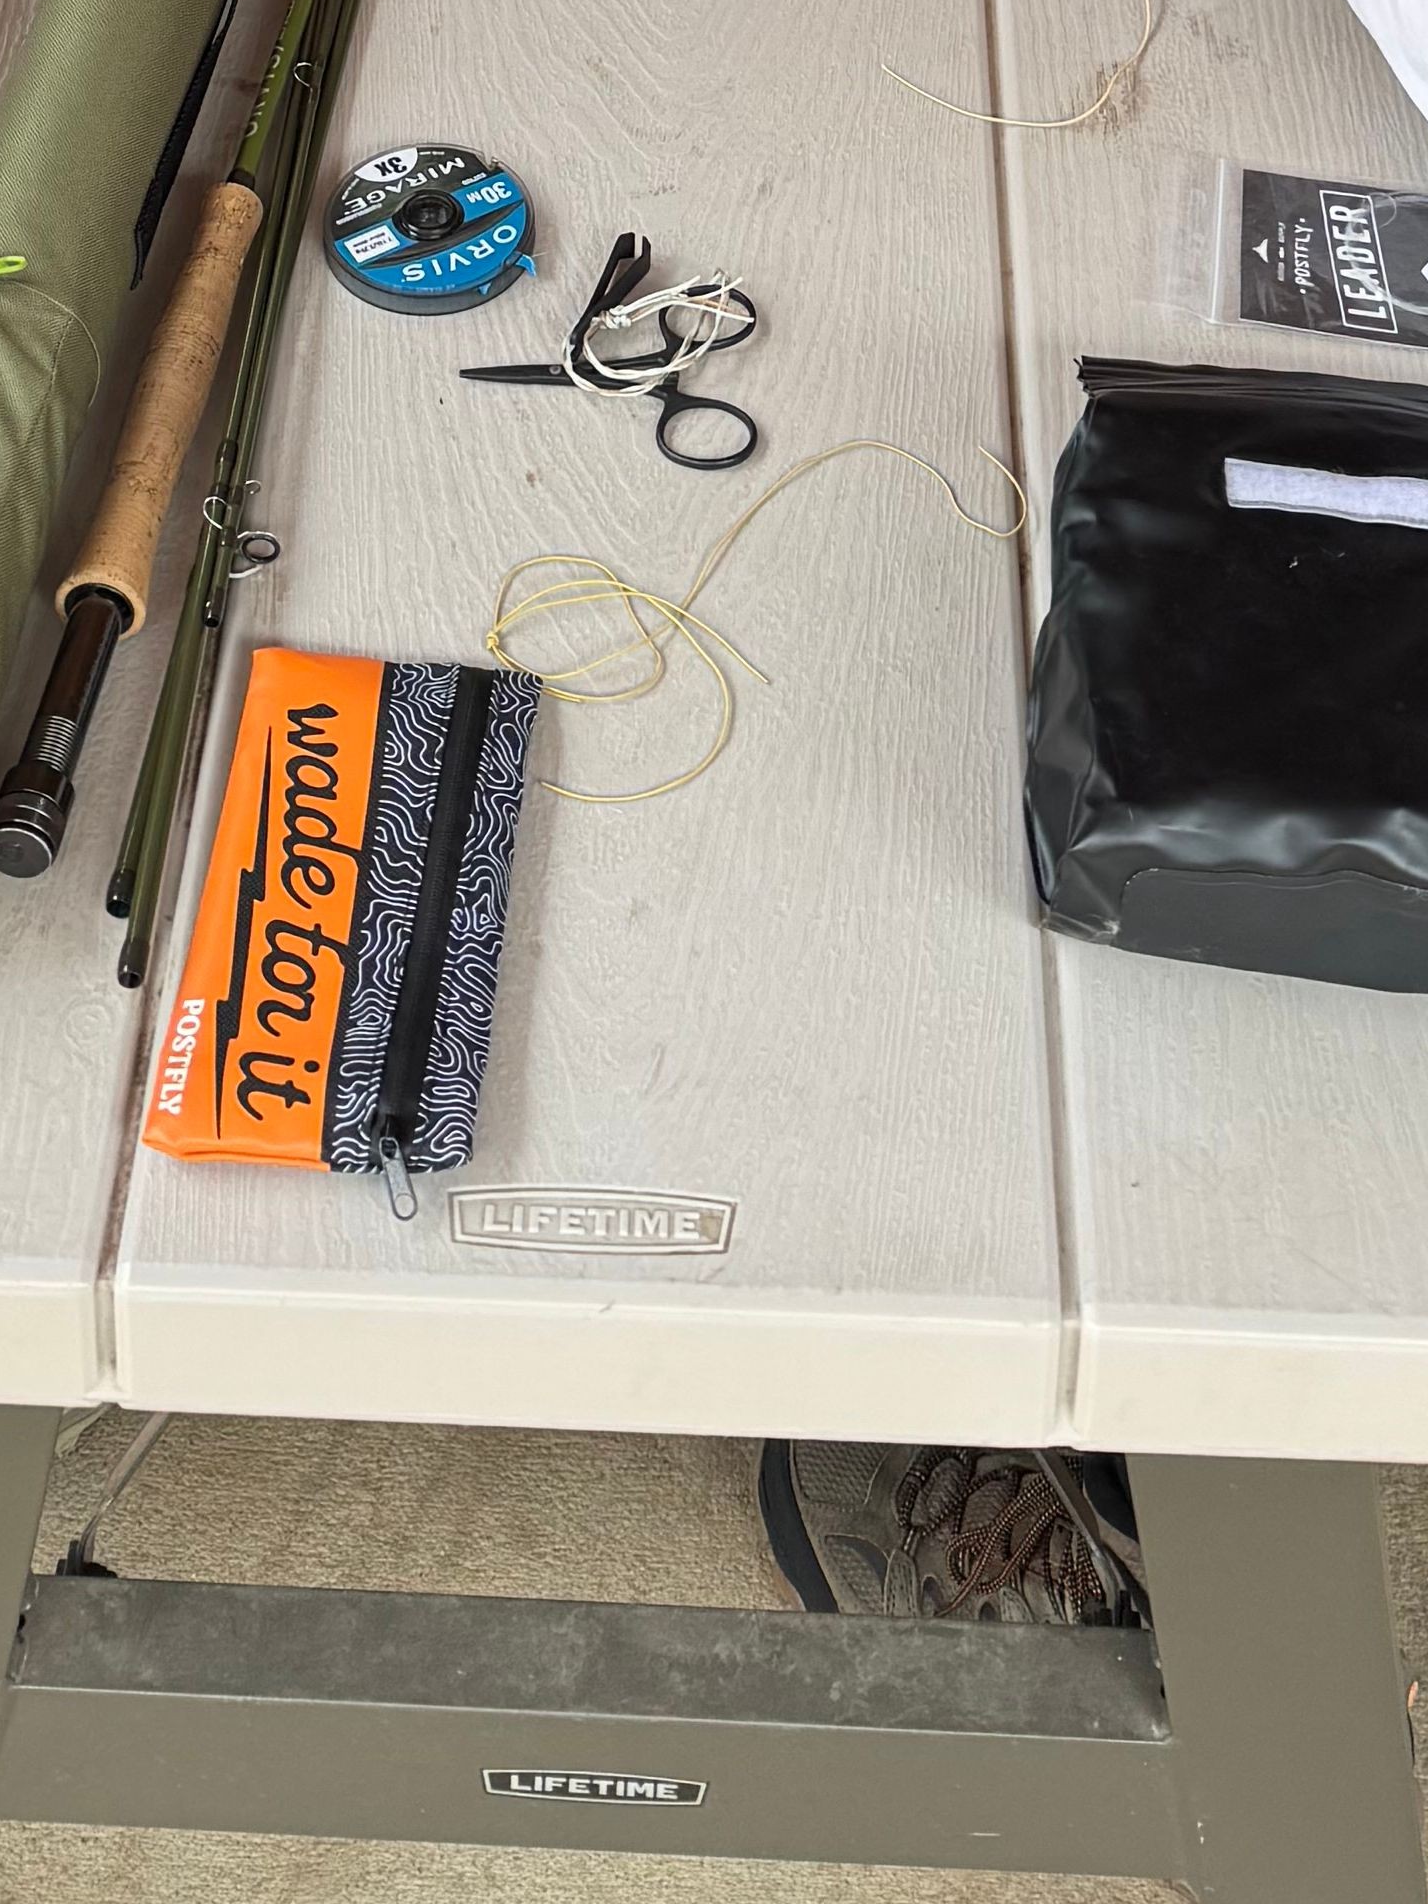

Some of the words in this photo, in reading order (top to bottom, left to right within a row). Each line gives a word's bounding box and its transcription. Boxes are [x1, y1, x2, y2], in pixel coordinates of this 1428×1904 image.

[344, 157, 466, 214] MIRAGE
[466, 181, 512, 204] 30M
[402, 225, 517, 281] ORVIS
[1294, 223, 1314, 288] POSTFLY
[1329, 204, 1389, 320] LEADER
[282, 703, 362, 910] wade
[158, 998, 206, 1116] POSTFLY
[236, 1051, 321, 1121] it
[482, 1203, 701, 1240] LIFETIME
[510, 1774, 679, 1800] LIFETIME
